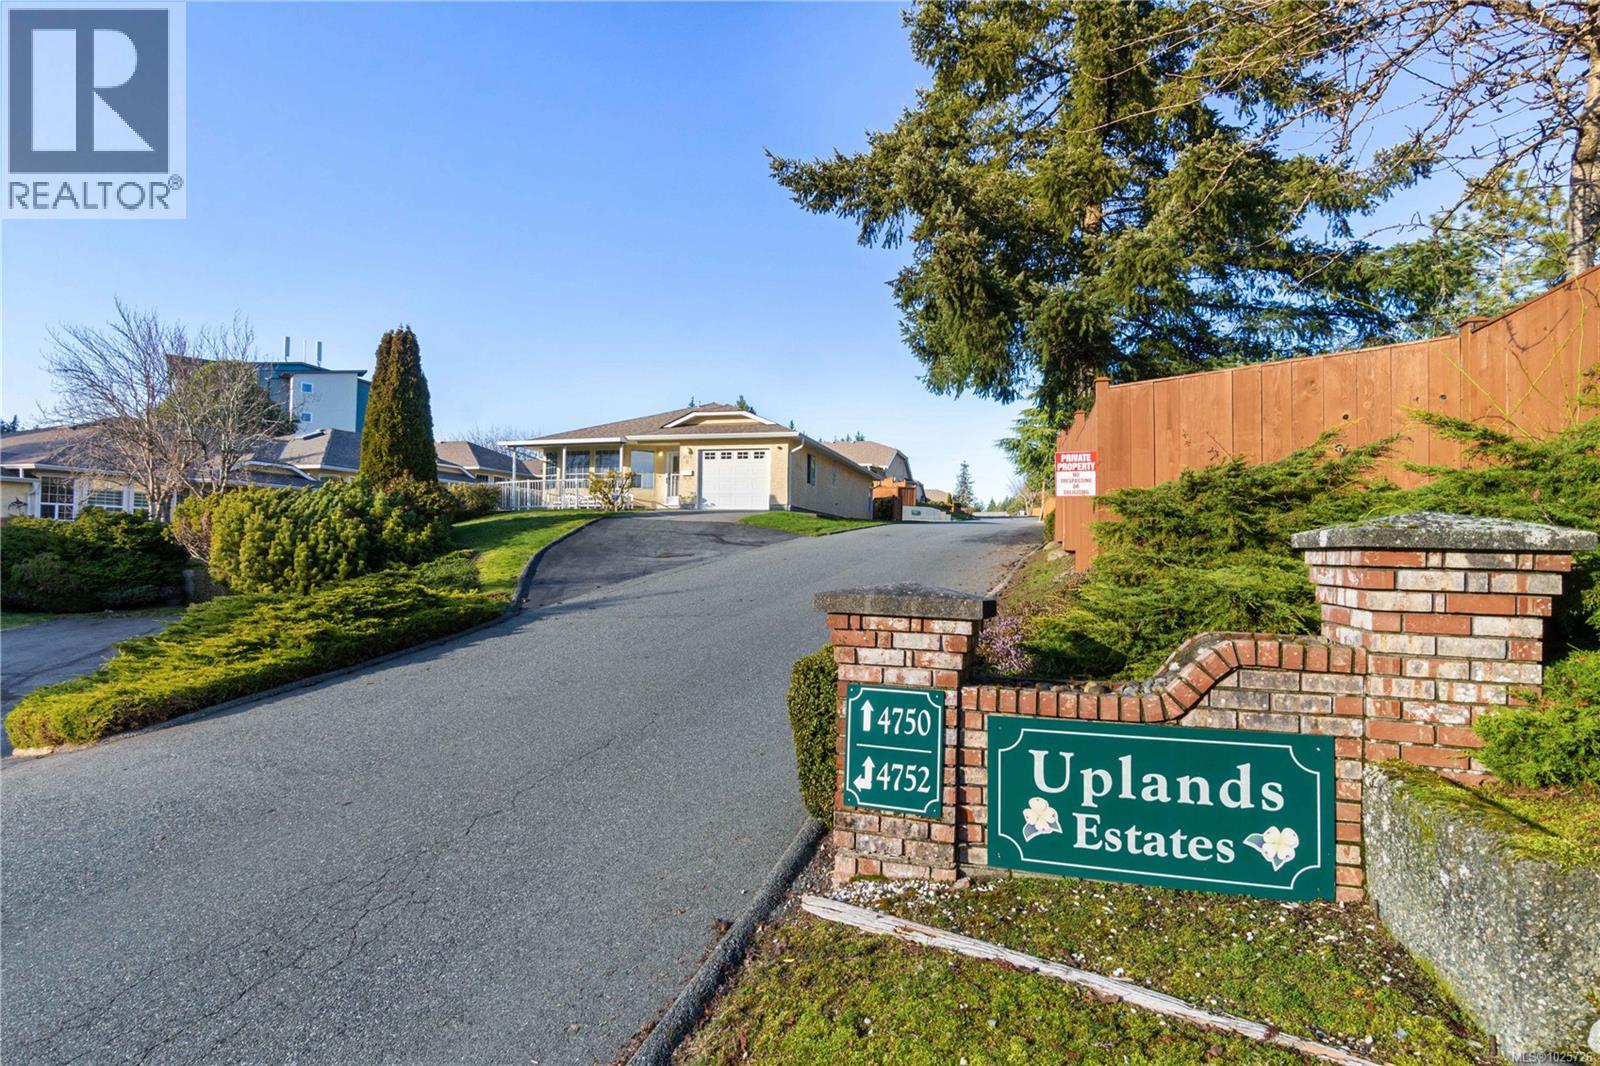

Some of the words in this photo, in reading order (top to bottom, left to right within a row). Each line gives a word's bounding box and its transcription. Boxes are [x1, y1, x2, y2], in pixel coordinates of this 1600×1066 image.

[1056, 462, 1096, 471] PROPERTY
[1060, 453, 1092, 462] PRIVATE
[877, 706, 932, 736] 4750
[876, 762, 931, 794] 4752
[1028, 749, 1285, 812] Uplands
[1072, 812, 1236, 864] Estates
